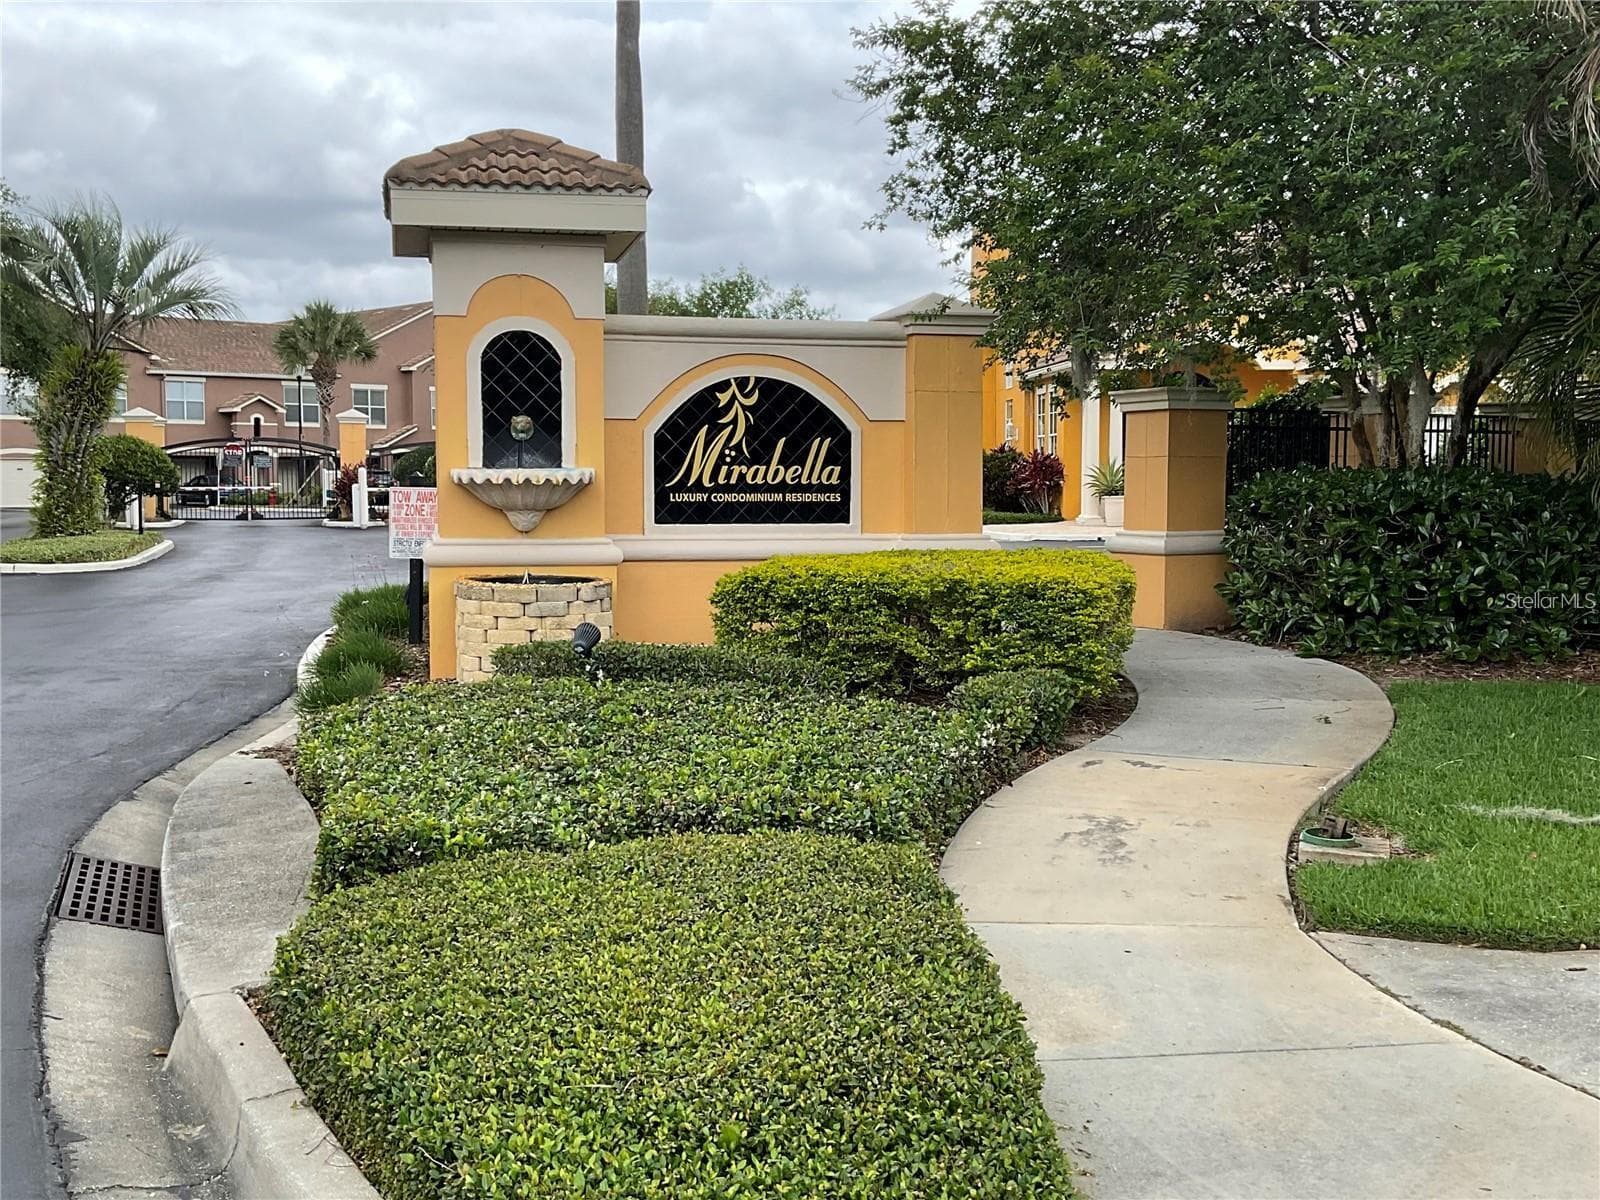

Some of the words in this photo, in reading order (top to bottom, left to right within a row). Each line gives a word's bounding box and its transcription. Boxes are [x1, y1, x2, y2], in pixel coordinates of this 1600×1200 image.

[665, 424, 842, 487] Mirabella
[392, 491, 411, 503] TOW
[416, 491, 438, 503] AWAY
[670, 493, 708, 503] LUXURY
[711, 493, 783, 503] CONDOMINIUM
[785, 493, 841, 503] RESIDENCES
[405, 504, 425, 516] ZONE
